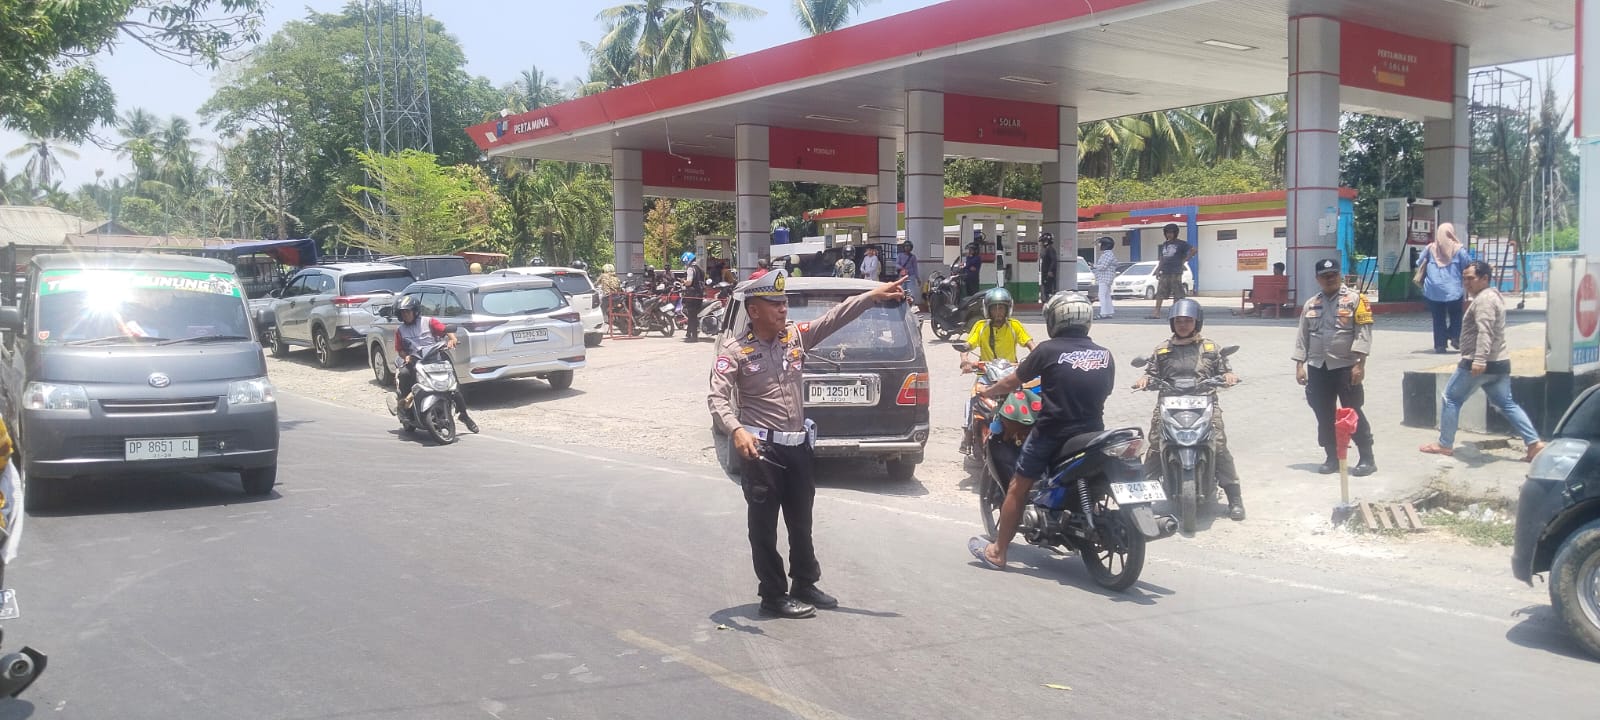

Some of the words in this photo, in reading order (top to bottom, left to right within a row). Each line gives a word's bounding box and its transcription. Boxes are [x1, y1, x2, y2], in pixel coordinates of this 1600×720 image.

[513, 117, 549, 134] PERTAMINA
[999, 117, 1021, 128] SOLAR
[811, 386, 822, 397] DD
[826, 386, 849, 397] 1250
[129, 441, 142, 454] DP
[148, 440, 173, 453] 8651
[182, 439, 195, 452] CL
